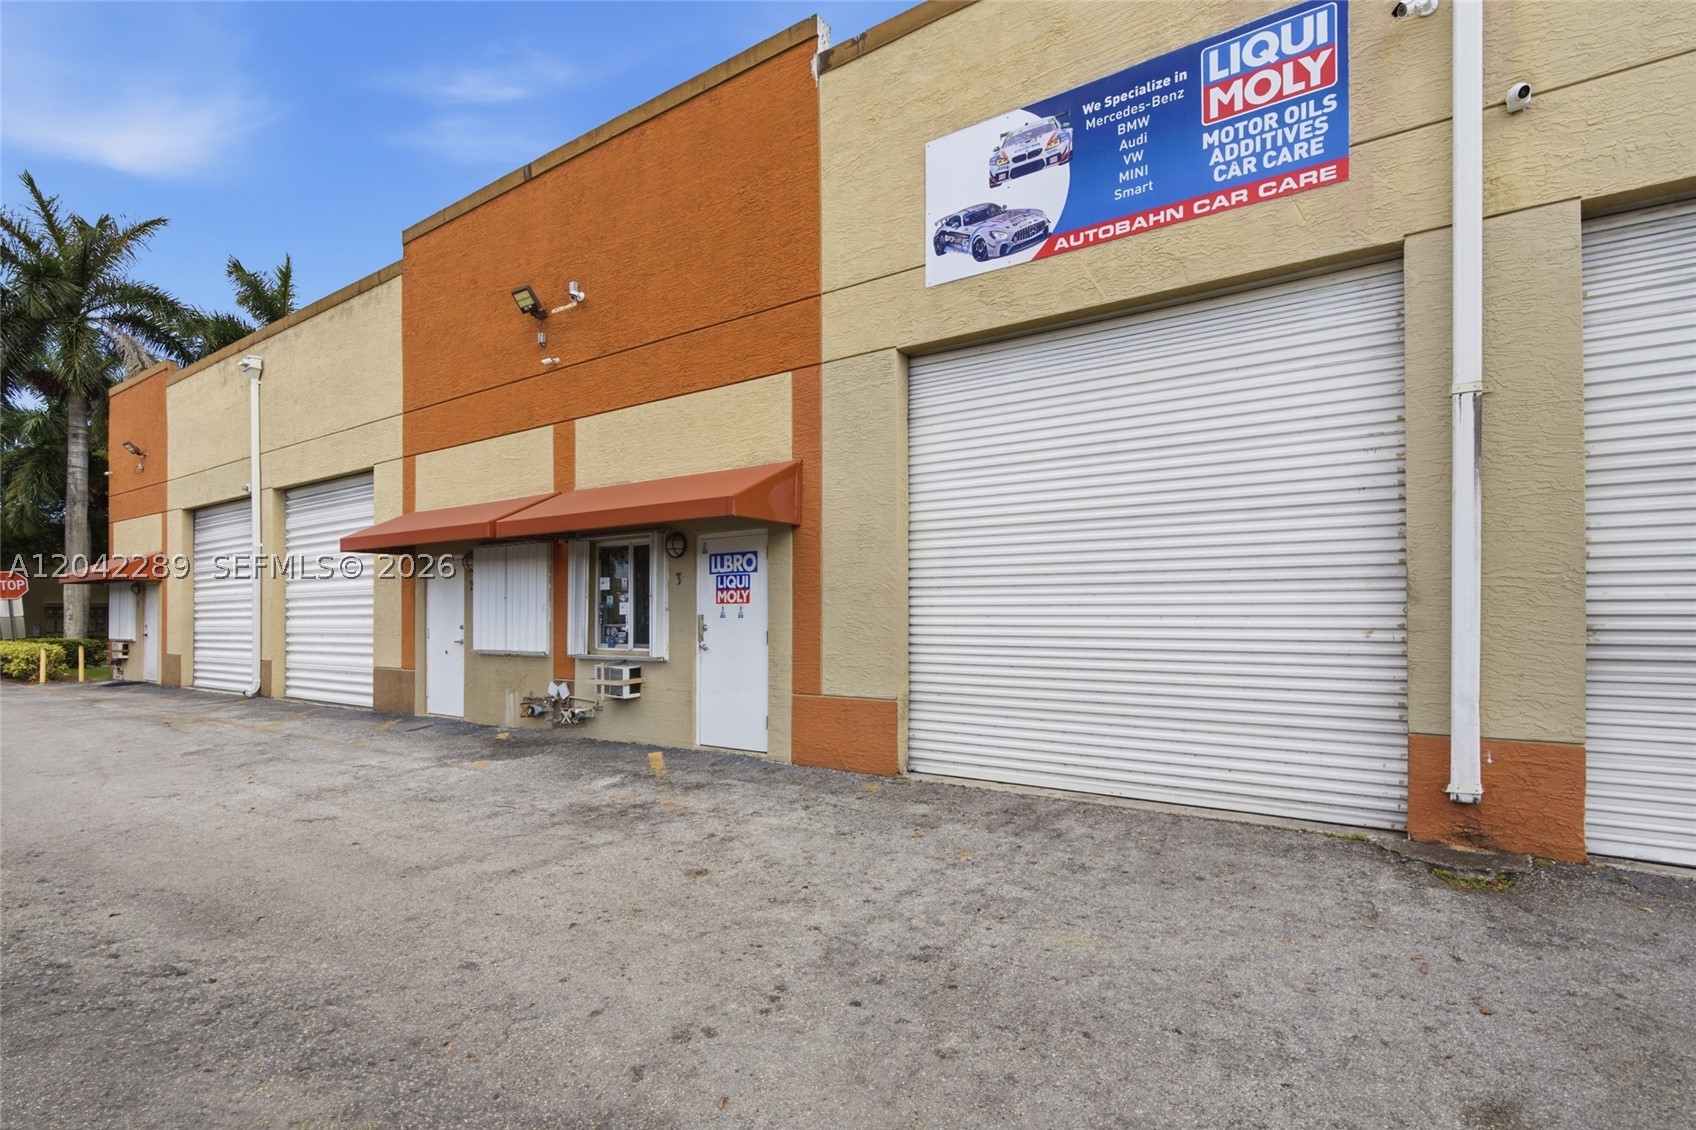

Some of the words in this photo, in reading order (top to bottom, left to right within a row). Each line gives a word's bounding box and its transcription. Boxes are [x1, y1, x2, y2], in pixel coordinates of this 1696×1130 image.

[1209, 9, 1328, 82] LIQUI
[1082, 101, 1101, 115] We
[1104, 76, 1171, 108] Specialize
[1174, 71, 1187, 83] in
[1209, 48, 1333, 120] MOLY
[1085, 89, 1184, 130] Mercedes-Benz
[1117, 115, 1150, 135] BMW
[1202, 112, 1278, 150] MOTOR
[1284, 93, 1337, 124] OILS
[1119, 132, 1147, 151] Audi
[1209, 116, 1329, 166] ADDITIVES
[1123, 150, 1144, 165] VW
[1213, 156, 1257, 182] CAR
[1263, 136, 1324, 169] CARE
[1119, 165, 1148, 183] MINI
[1114, 180, 1153, 200] Smart
[1053, 205, 1184, 251] AUTOBAHN
[1193, 189, 1248, 214] CAR
[1258, 165, 1337, 197] CARE
[0, 579, 25, 591] TOP
[676, 572, 682, 586] 3
[717, 575, 749, 589] LIQUI
[717, 590, 750, 604] MOLY
